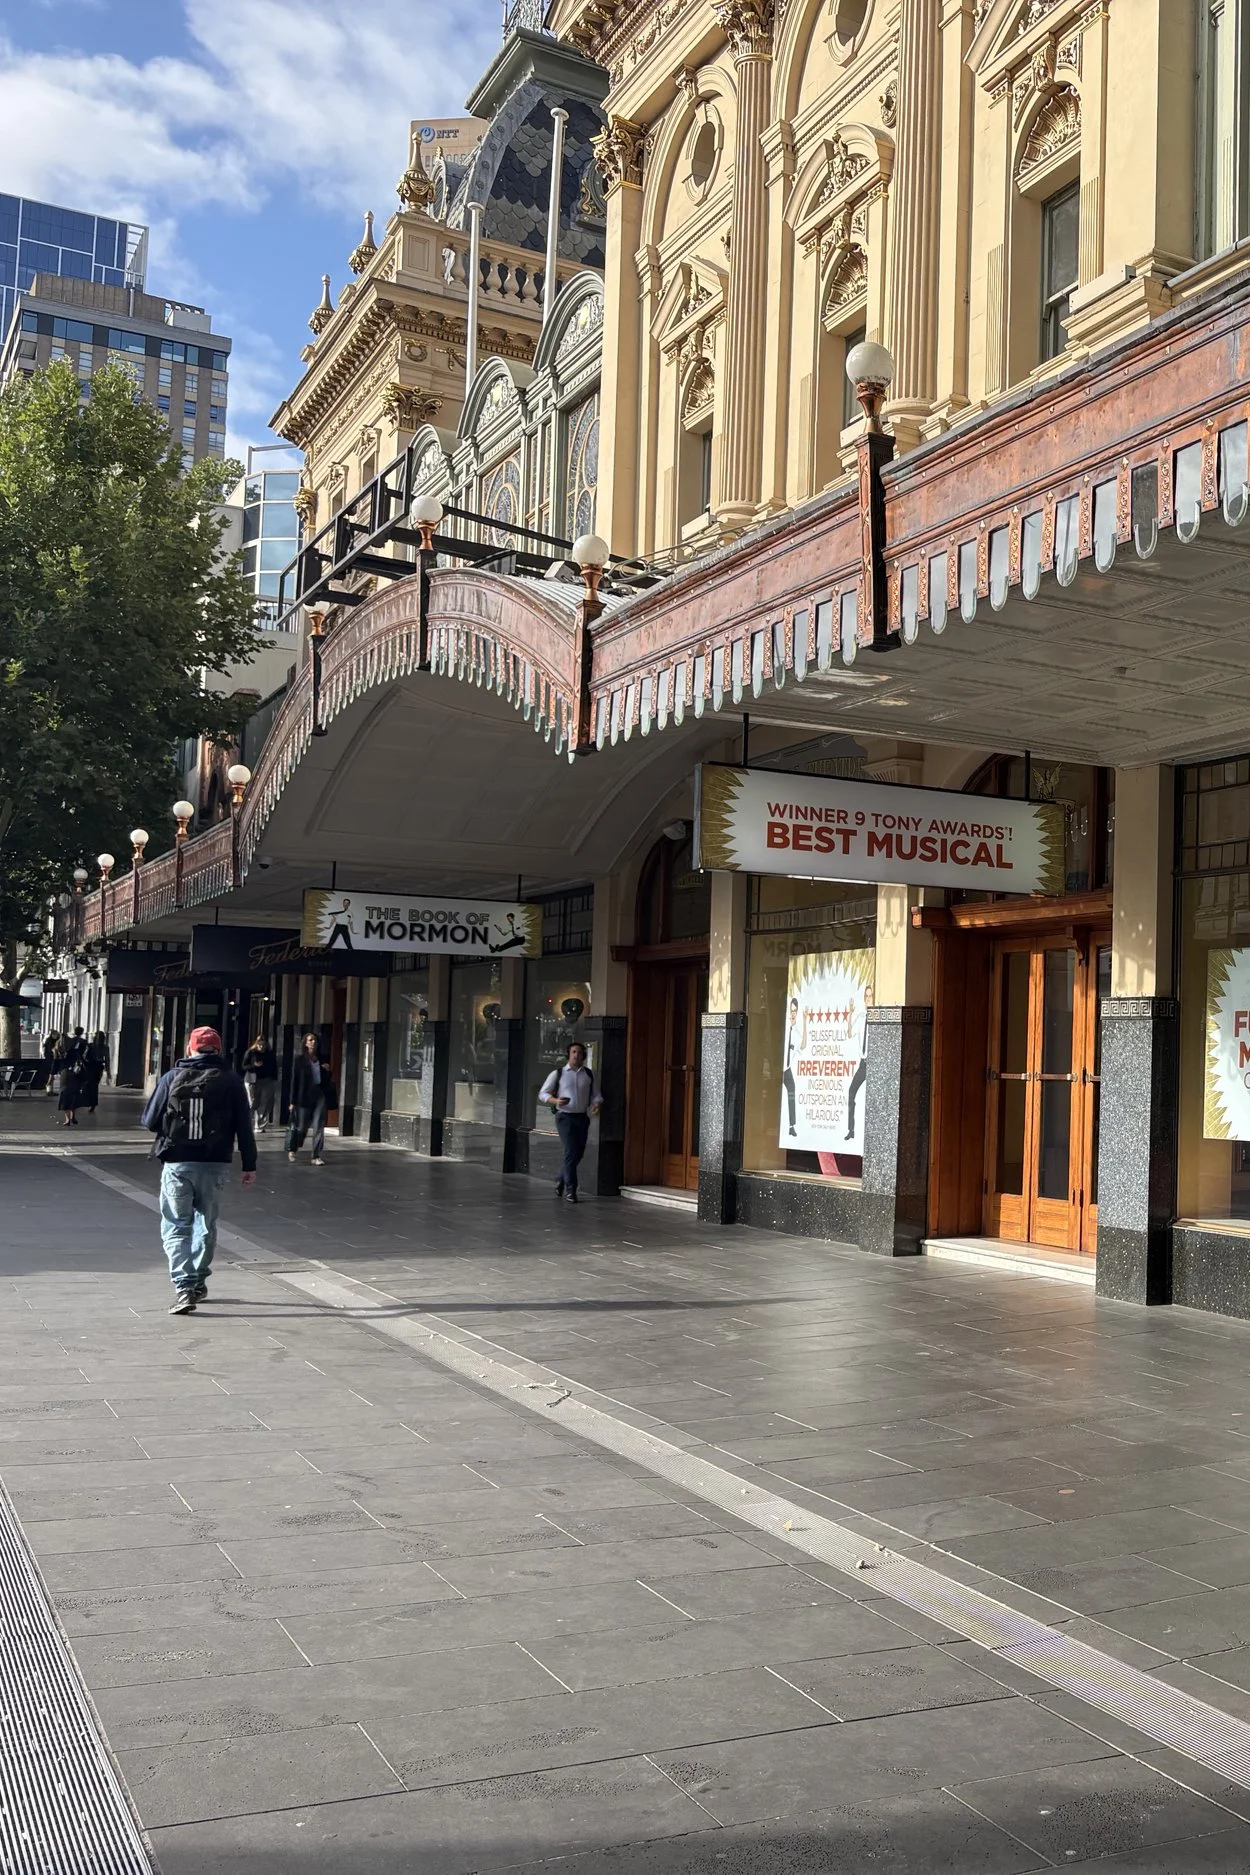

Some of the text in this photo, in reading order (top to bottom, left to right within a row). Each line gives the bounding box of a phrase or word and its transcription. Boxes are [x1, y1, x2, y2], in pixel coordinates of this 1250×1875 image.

[436, 129, 459, 139] NTT
[766, 802, 848, 825] WINNER
[855, 811, 866, 826] 9
[871, 813, 922, 831] TONY
[766, 821, 1013, 870] BEST MUSICAL
[365, 906, 490, 926] THE BOOK OF
[364, 920, 489, 945] MORMON
[797, 1060, 856, 1077] IRREVERENT
[798, 1093, 837, 1106] OUTSPOKEN
